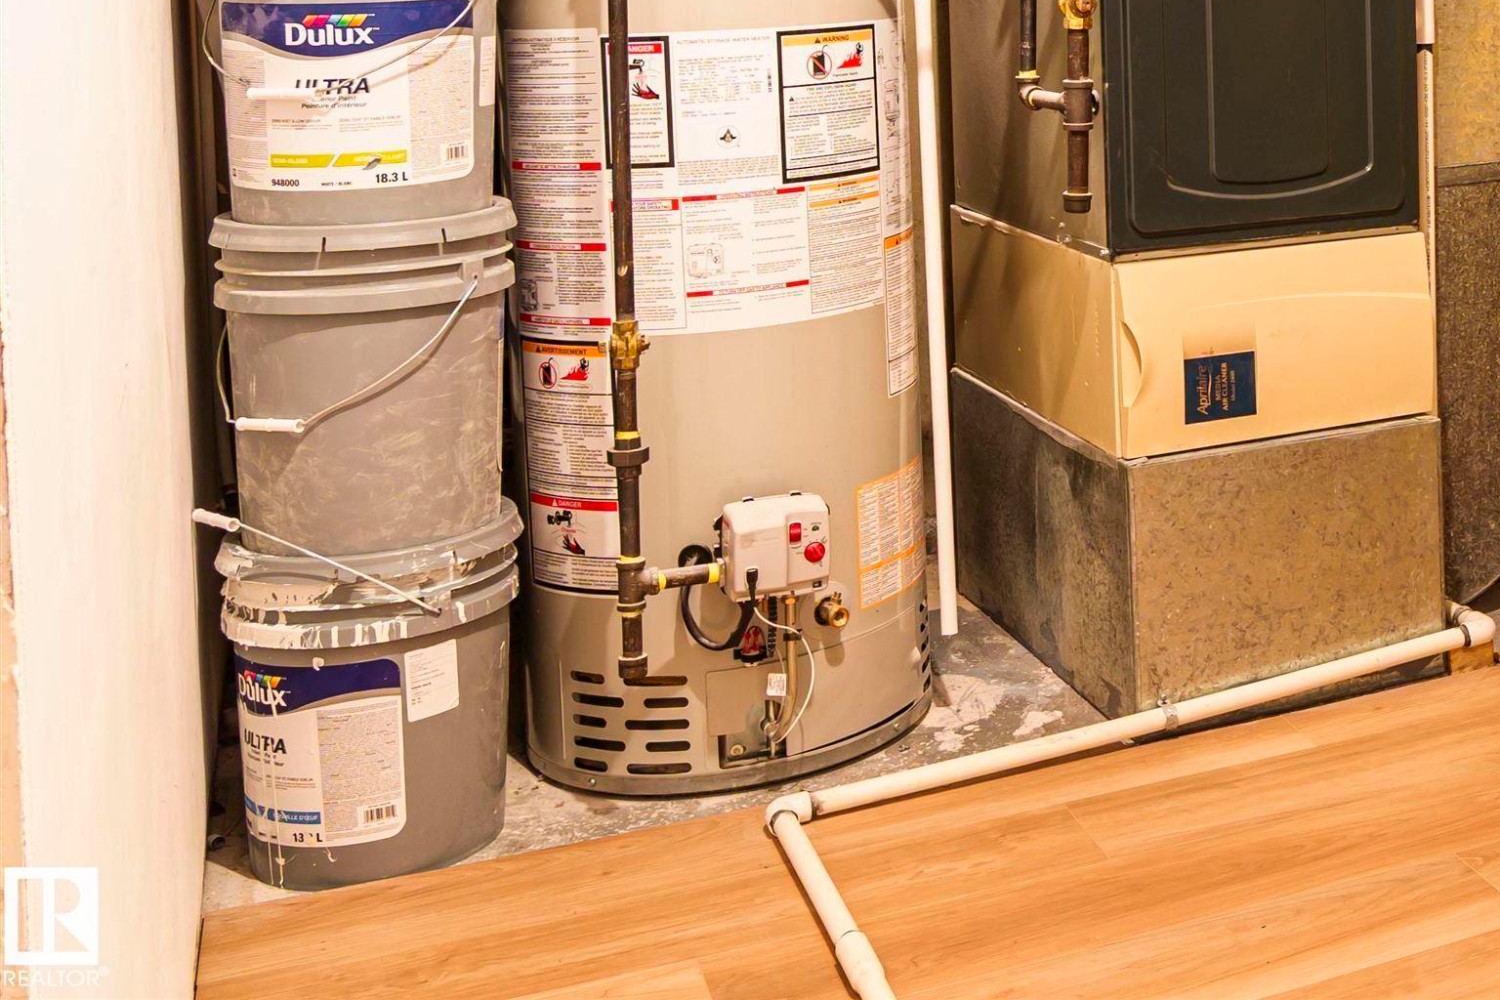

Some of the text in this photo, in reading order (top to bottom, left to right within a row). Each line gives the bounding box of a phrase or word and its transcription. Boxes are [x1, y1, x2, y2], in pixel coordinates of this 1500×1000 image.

[284, 22, 376, 46] Dulux
[822, 34, 850, 43] WARNING
[270, 178, 300, 187] 948000
[375, 170, 409, 184] 18.3 L
[541, 346, 587, 356] AVERTISSEMENT
[1196, 364, 1209, 415] Aprilaire
[557, 500, 582, 509] DANGER
[238, 672, 288, 707] Dulux
[316, 832, 323, 843] L
